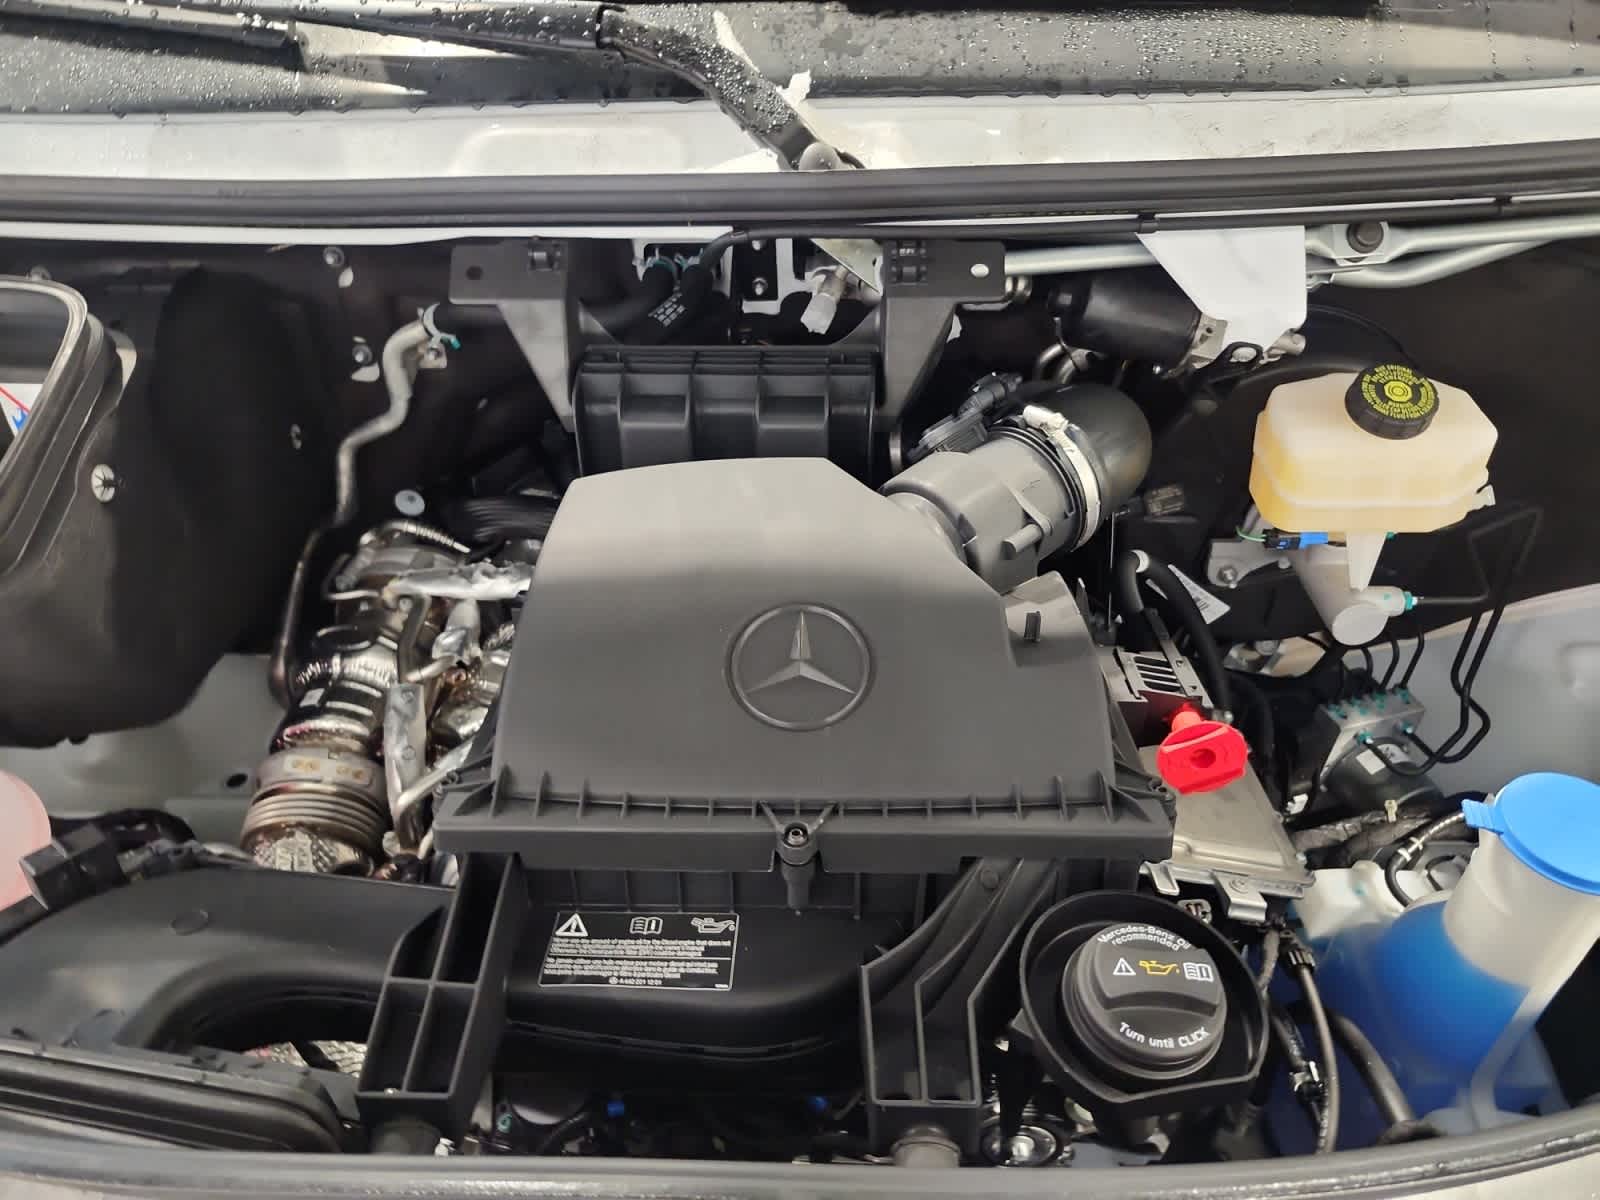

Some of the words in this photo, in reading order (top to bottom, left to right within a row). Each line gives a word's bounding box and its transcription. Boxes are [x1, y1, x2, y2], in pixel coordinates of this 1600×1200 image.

[1097, 925, 1175, 943] Mercedes-Benz
[1176, 937, 1192, 950] Oil
[1111, 932, 1181, 952] recommended
[1119, 1021, 1145, 1044] Turn
[1148, 1037, 1175, 1049] until
[1178, 1026, 1212, 1047] CLICK
